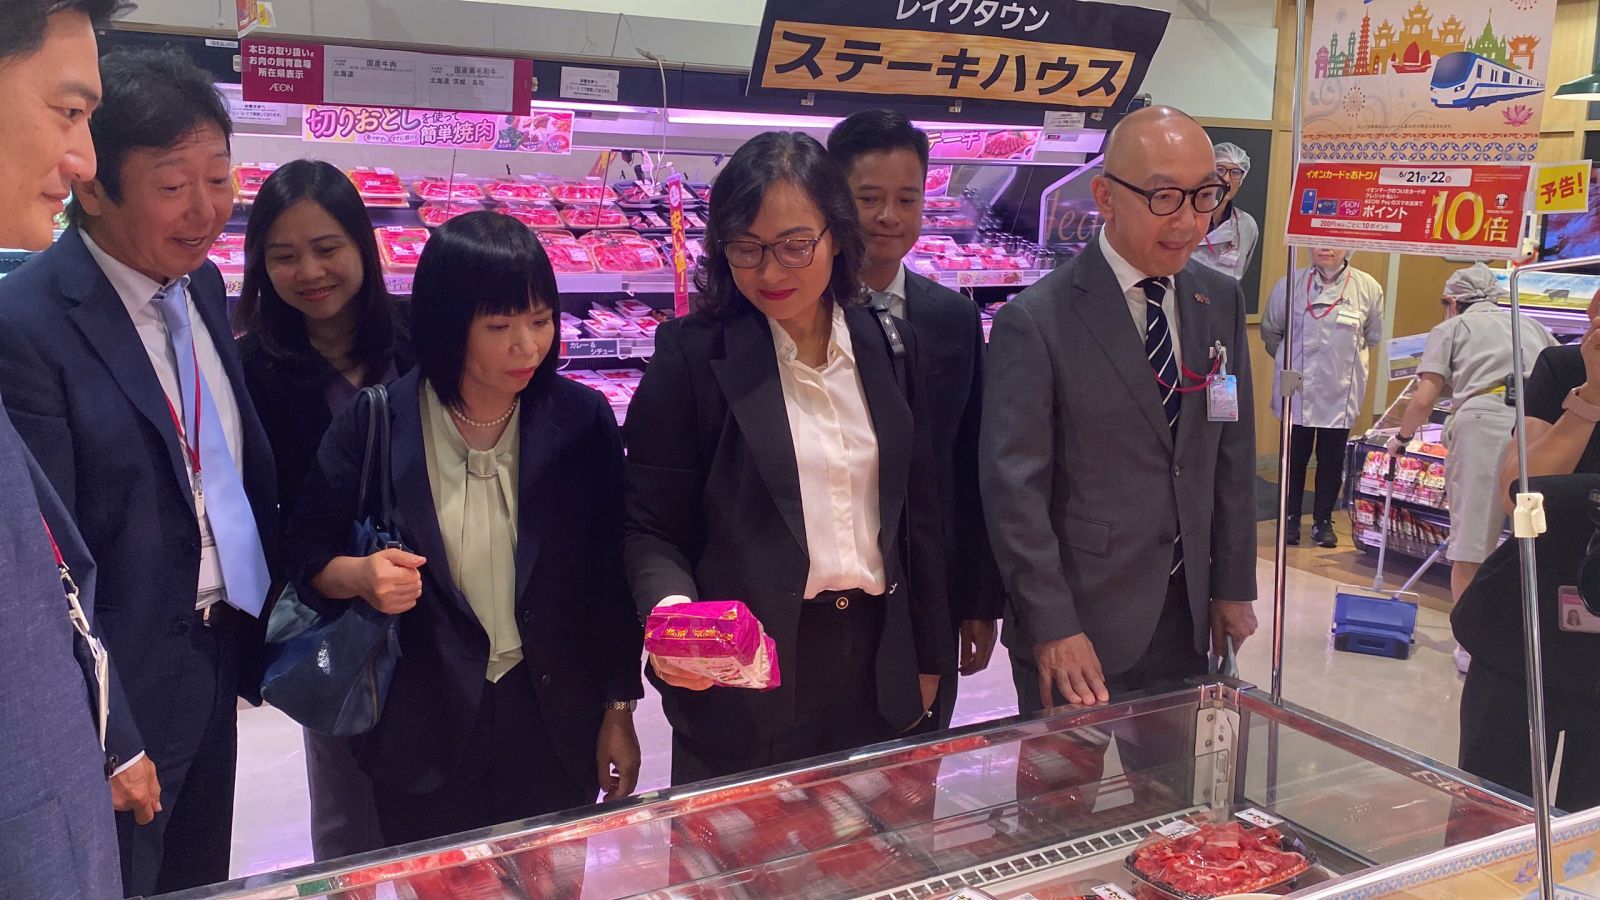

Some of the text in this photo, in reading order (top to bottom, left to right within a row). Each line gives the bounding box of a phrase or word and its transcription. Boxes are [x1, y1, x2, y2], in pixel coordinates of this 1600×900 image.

[896, 0, 1050, 31] レイクタウン
[249, 57, 312, 69] お肉の飼育農場
[366, 59, 397, 69] 国産牛肉
[774, 31, 1124, 98] ステーキハウス
[258, 68, 304, 79] 所在県表示
[333, 70, 354, 78] 北海道
[306, 107, 421, 138] 切りおとし
[422, 111, 460, 123] を使って
[420, 119, 496, 145] 簡単焼肉
[1540, 172, 1583, 205] 予告!
[1362, 206, 1408, 220] ポイント
